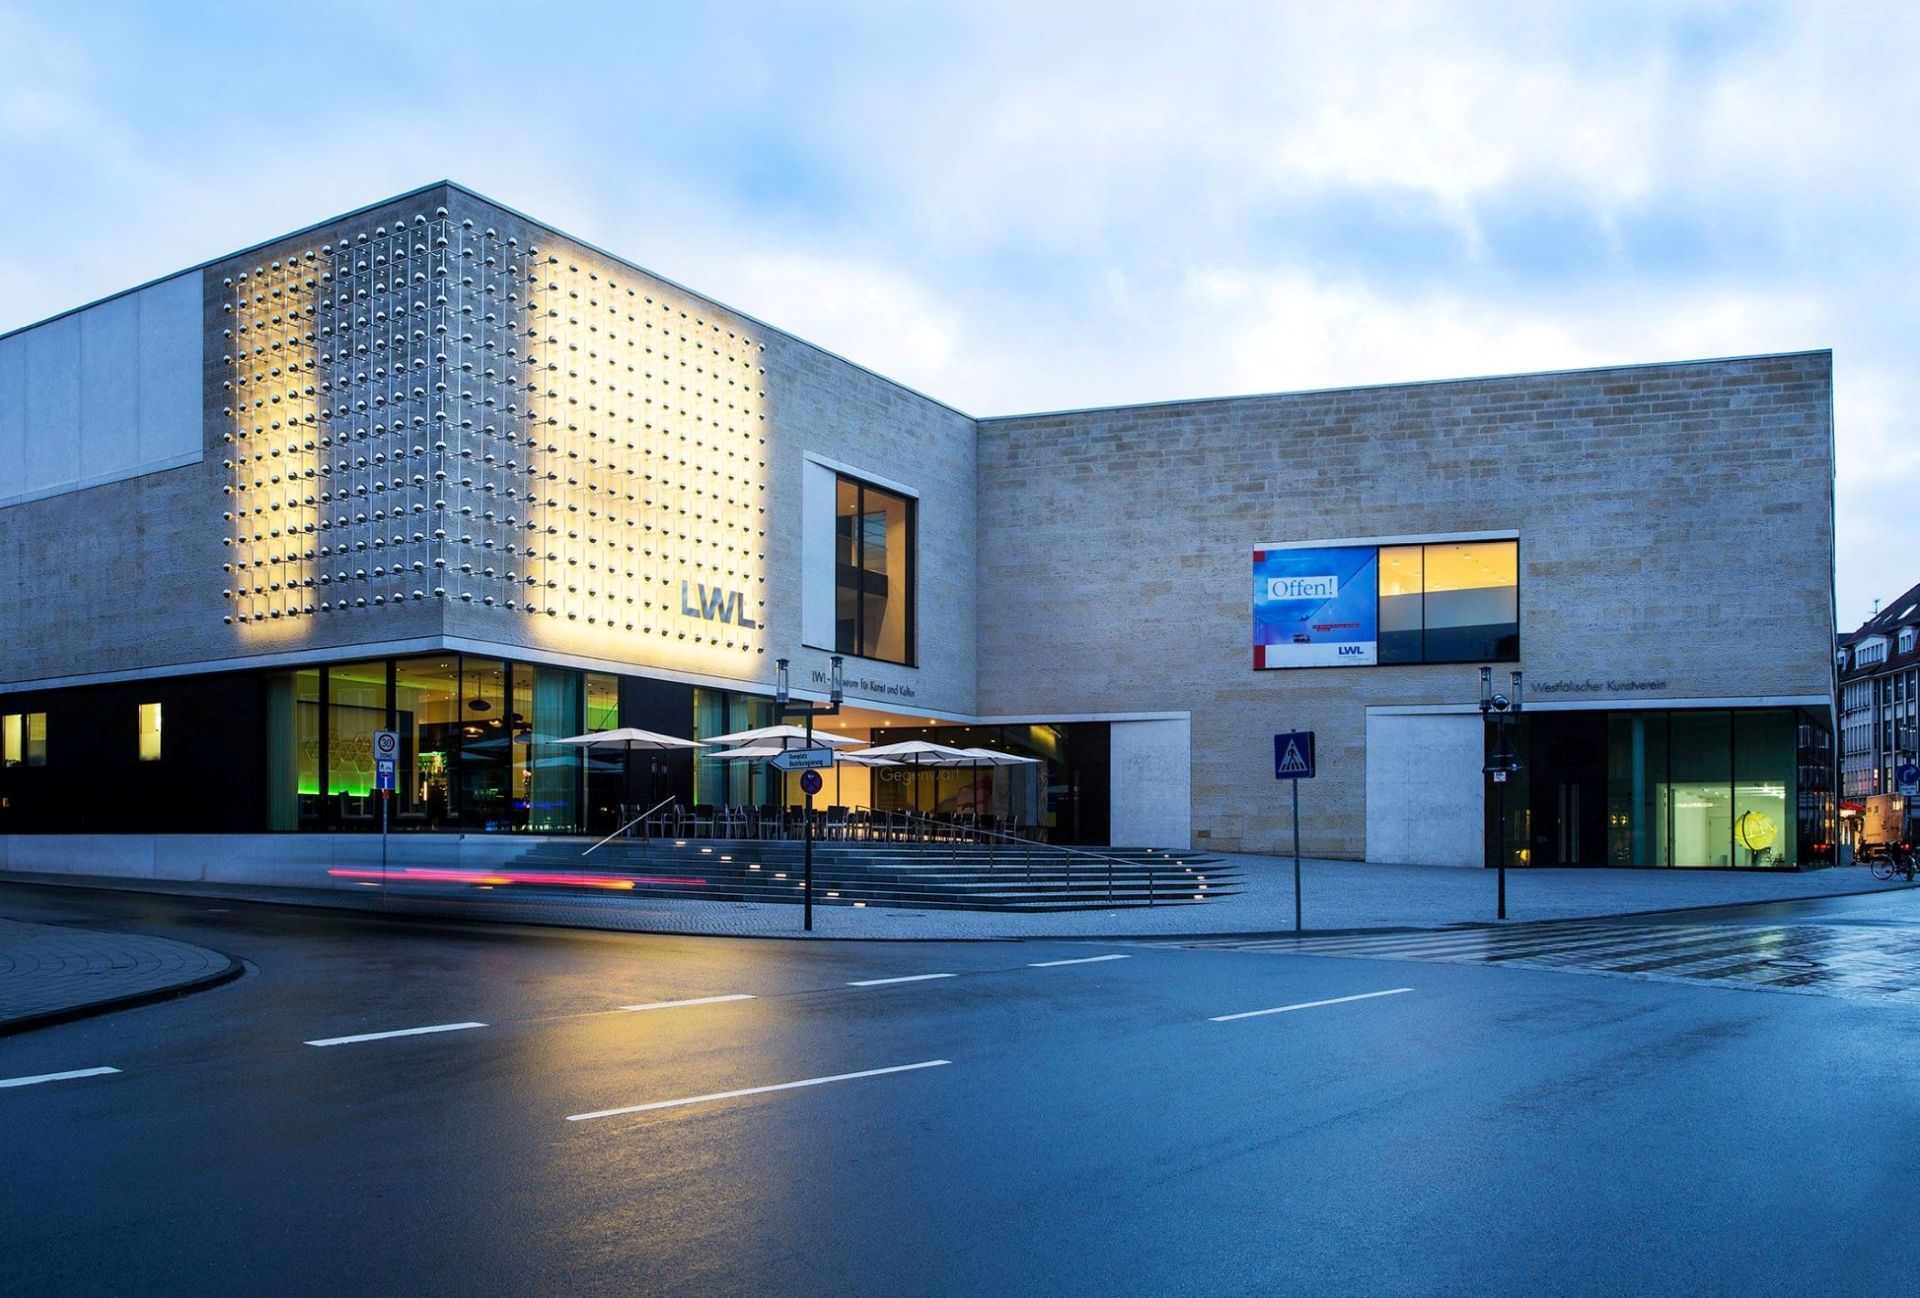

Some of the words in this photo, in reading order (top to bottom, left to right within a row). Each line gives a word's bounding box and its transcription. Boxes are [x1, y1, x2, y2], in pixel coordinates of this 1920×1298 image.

[1272, 578, 1333, 597] Offen!
[681, 579, 756, 629] LWL
[1338, 645, 1364, 655] LWL
[870, 679, 886, 693] Kunst
[887, 684, 898, 696] und
[1606, 679, 1666, 692] Kunstverein
[381, 738, 392, 748] 30
